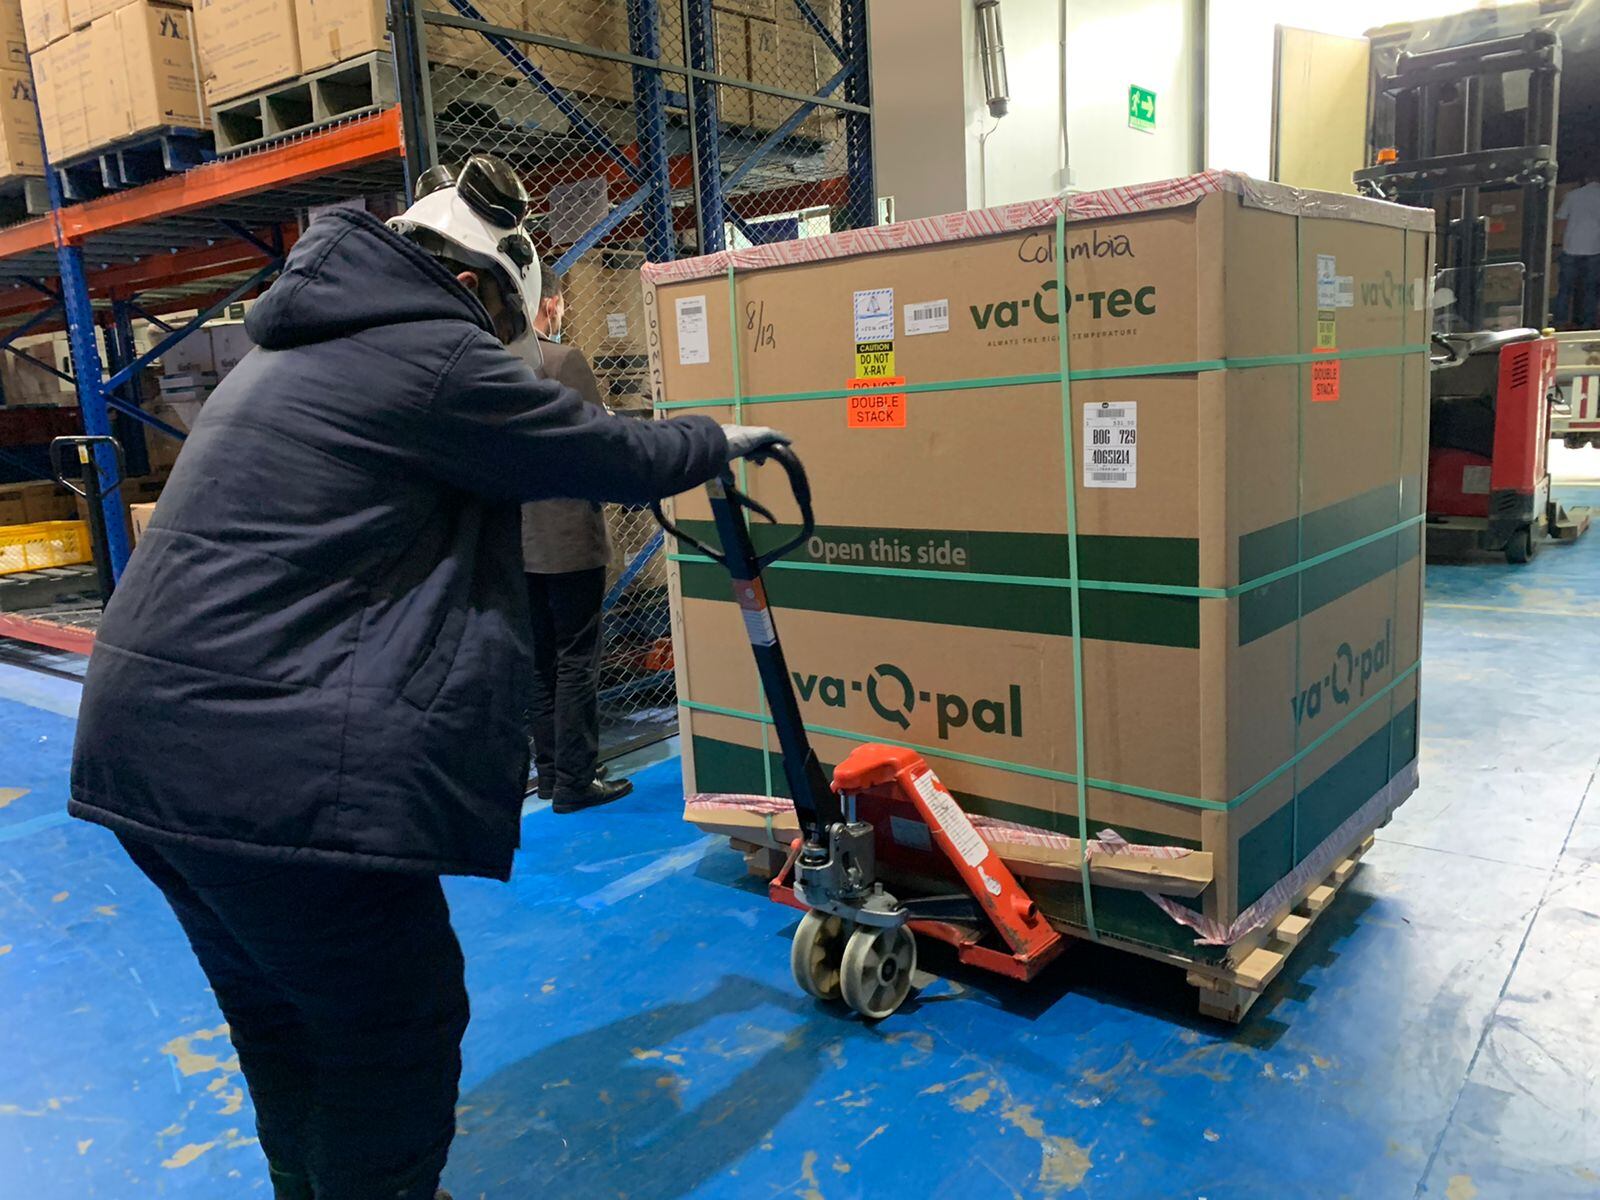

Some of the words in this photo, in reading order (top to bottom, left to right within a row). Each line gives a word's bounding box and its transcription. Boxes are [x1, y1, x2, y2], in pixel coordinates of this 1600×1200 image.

[860, 343, 890, 352] CAUTION
[860, 354, 872, 365] DO
[873, 353, 889, 364] NOT
[863, 365, 887, 376] X-RAY
[851, 396, 899, 409] DOUBLE
[856, 410, 894, 422] STACK
[1092, 429, 1110, 444] BOG
[1119, 429, 1136, 444] 729
[807, 536, 864, 564] Open
[869, 537, 912, 563] this
[917, 541, 967, 566] side
